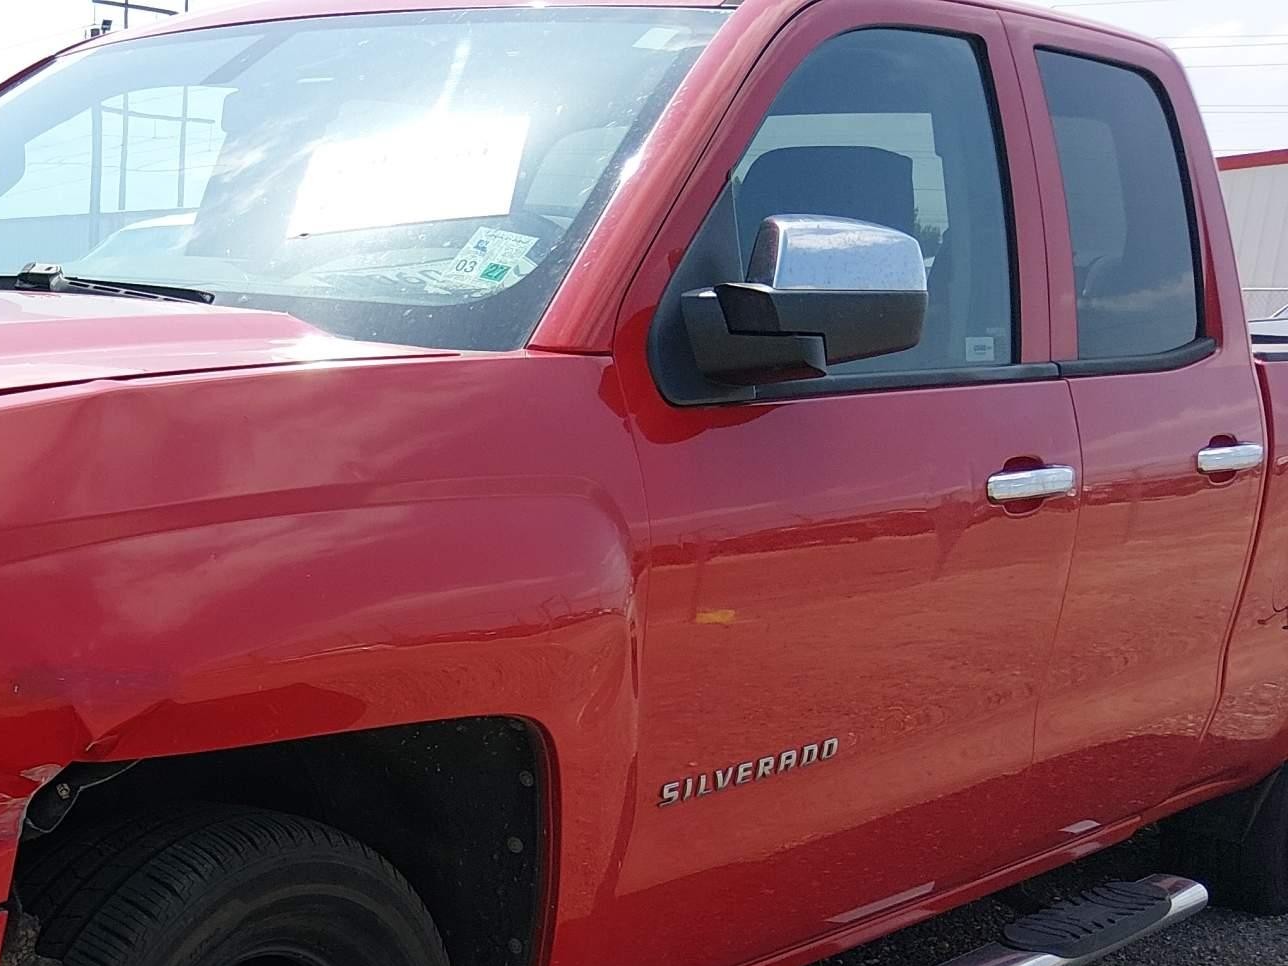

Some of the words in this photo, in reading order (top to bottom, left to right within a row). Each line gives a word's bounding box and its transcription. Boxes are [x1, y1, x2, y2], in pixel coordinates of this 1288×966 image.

[455, 259, 478, 273] 03
[486, 262, 511, 280] 27
[657, 736, 840, 809] SILVERADO
